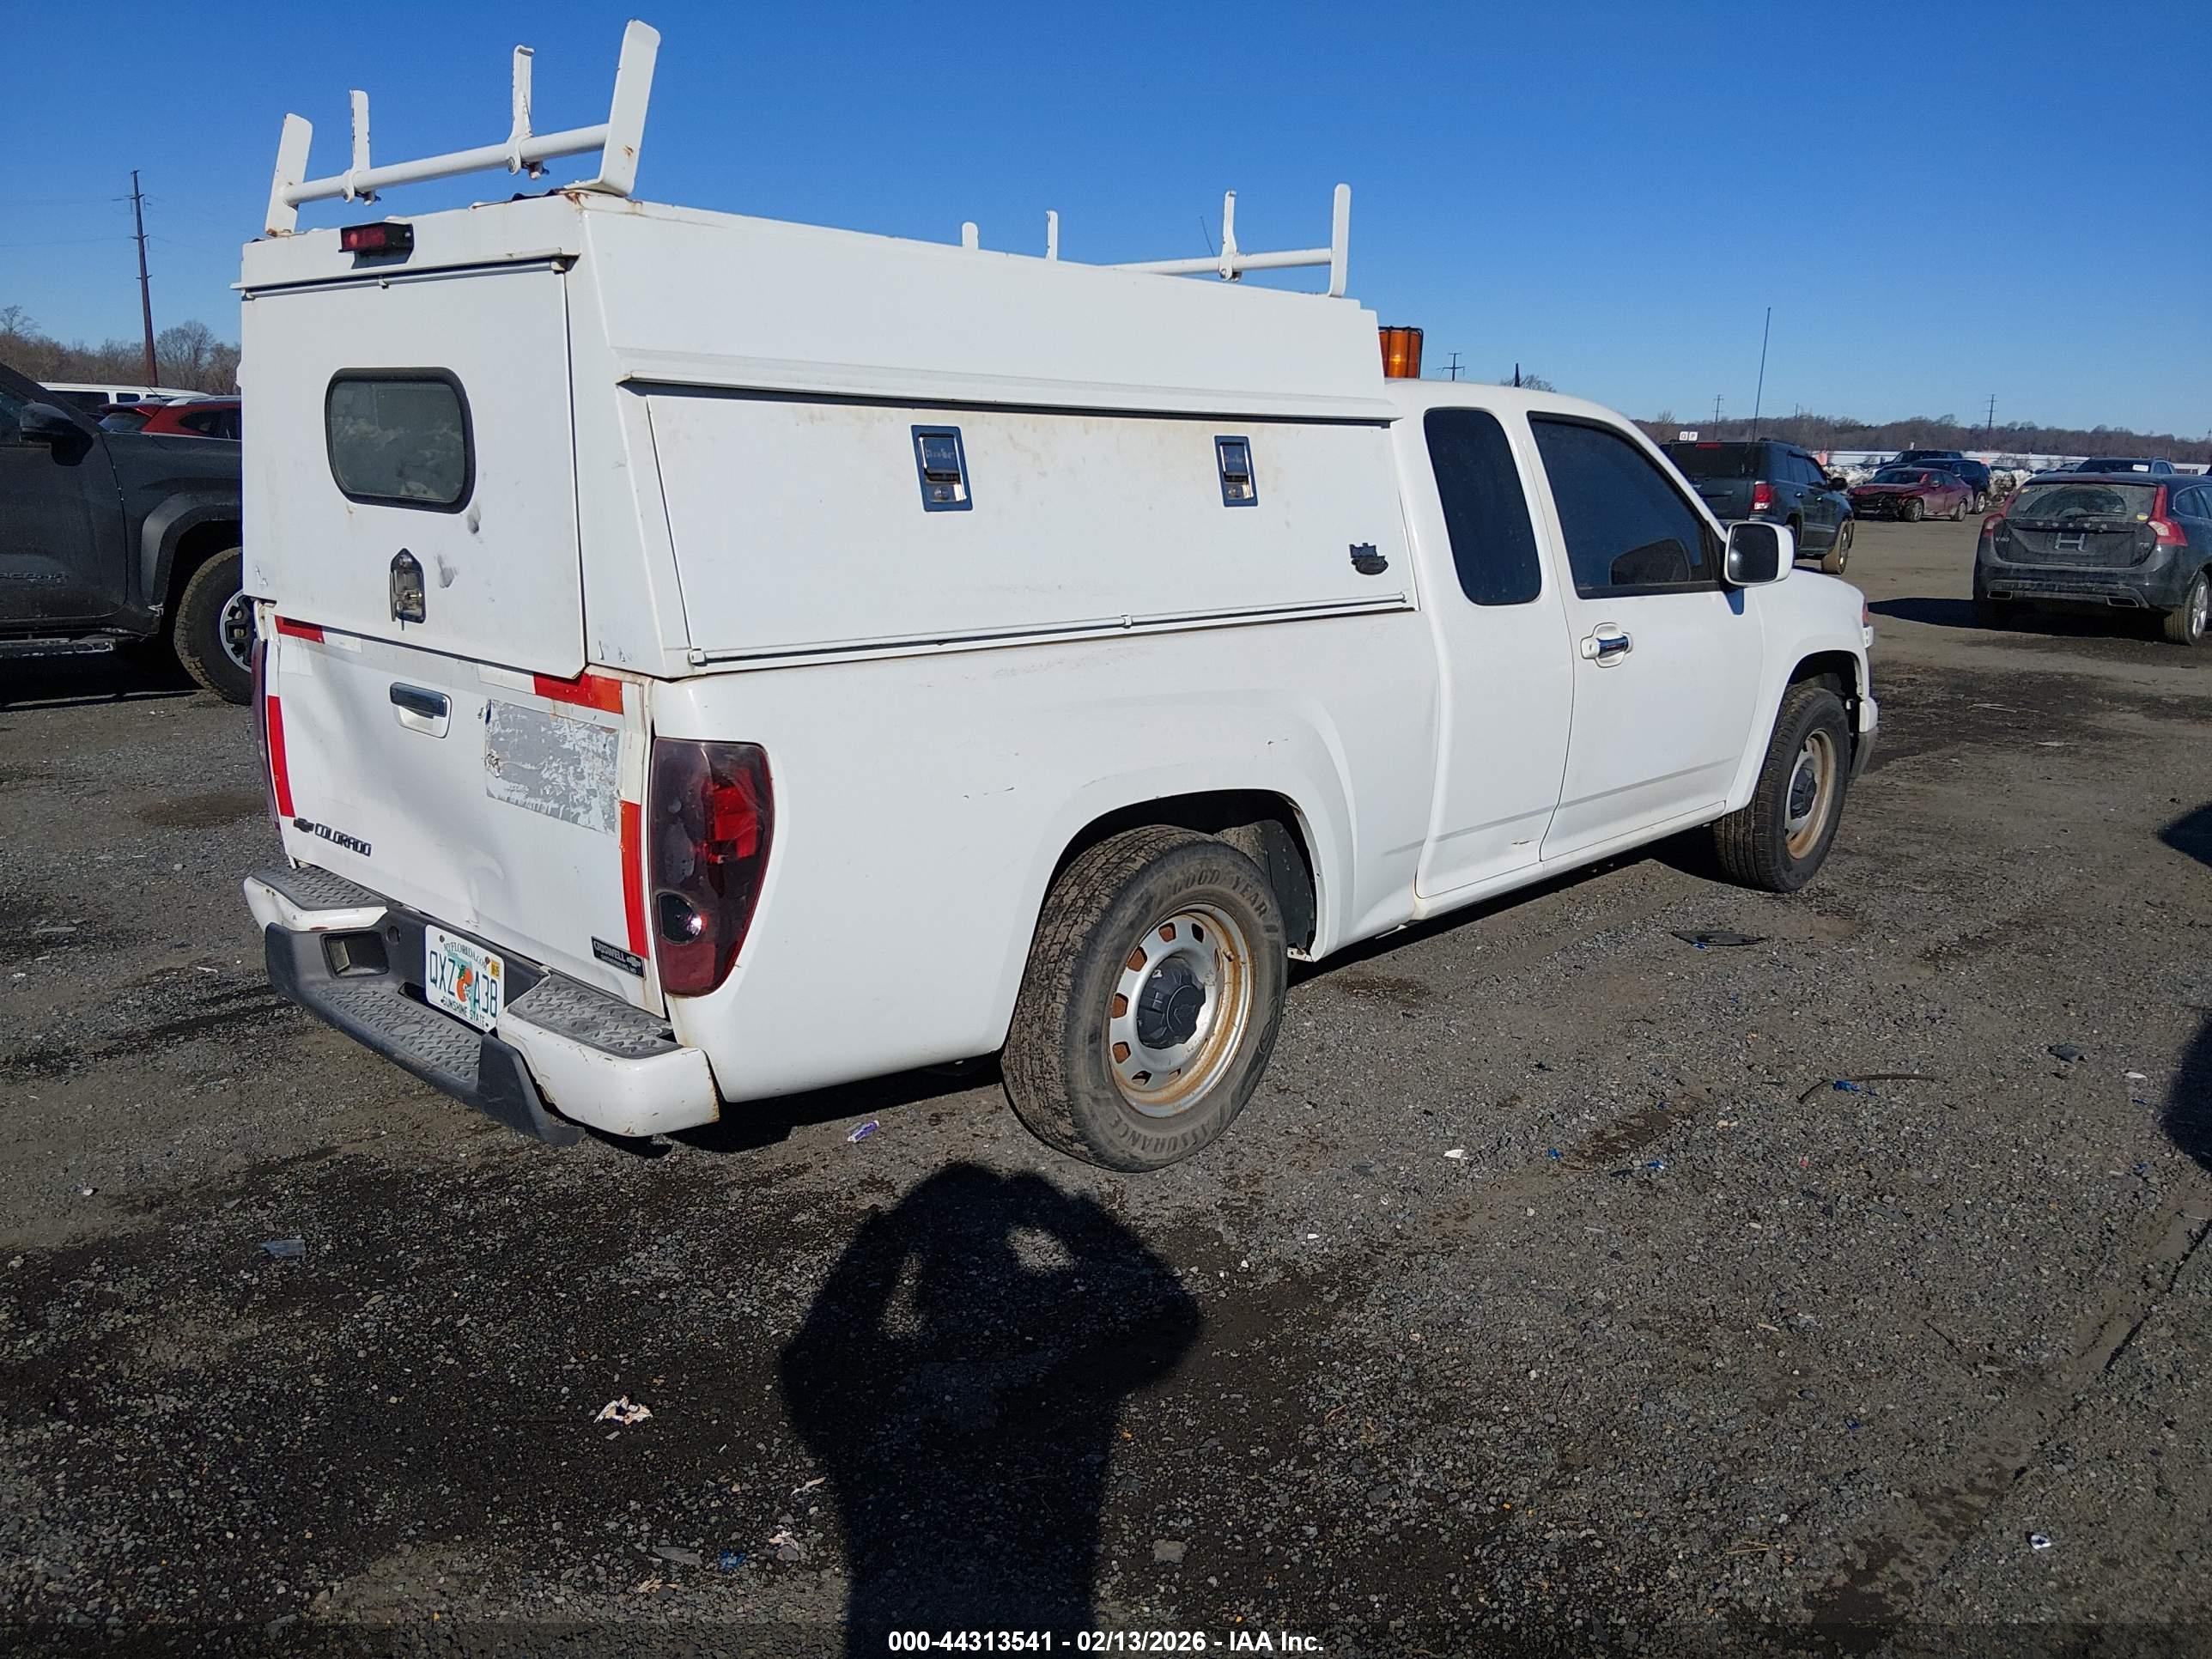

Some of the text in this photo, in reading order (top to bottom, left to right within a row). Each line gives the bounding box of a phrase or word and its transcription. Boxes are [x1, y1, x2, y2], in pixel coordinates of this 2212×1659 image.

[314, 823, 372, 857] COLORADO
[429, 950, 498, 1018] QXZ A38
[442, 996, 486, 1028] SUNSHINE STATE
